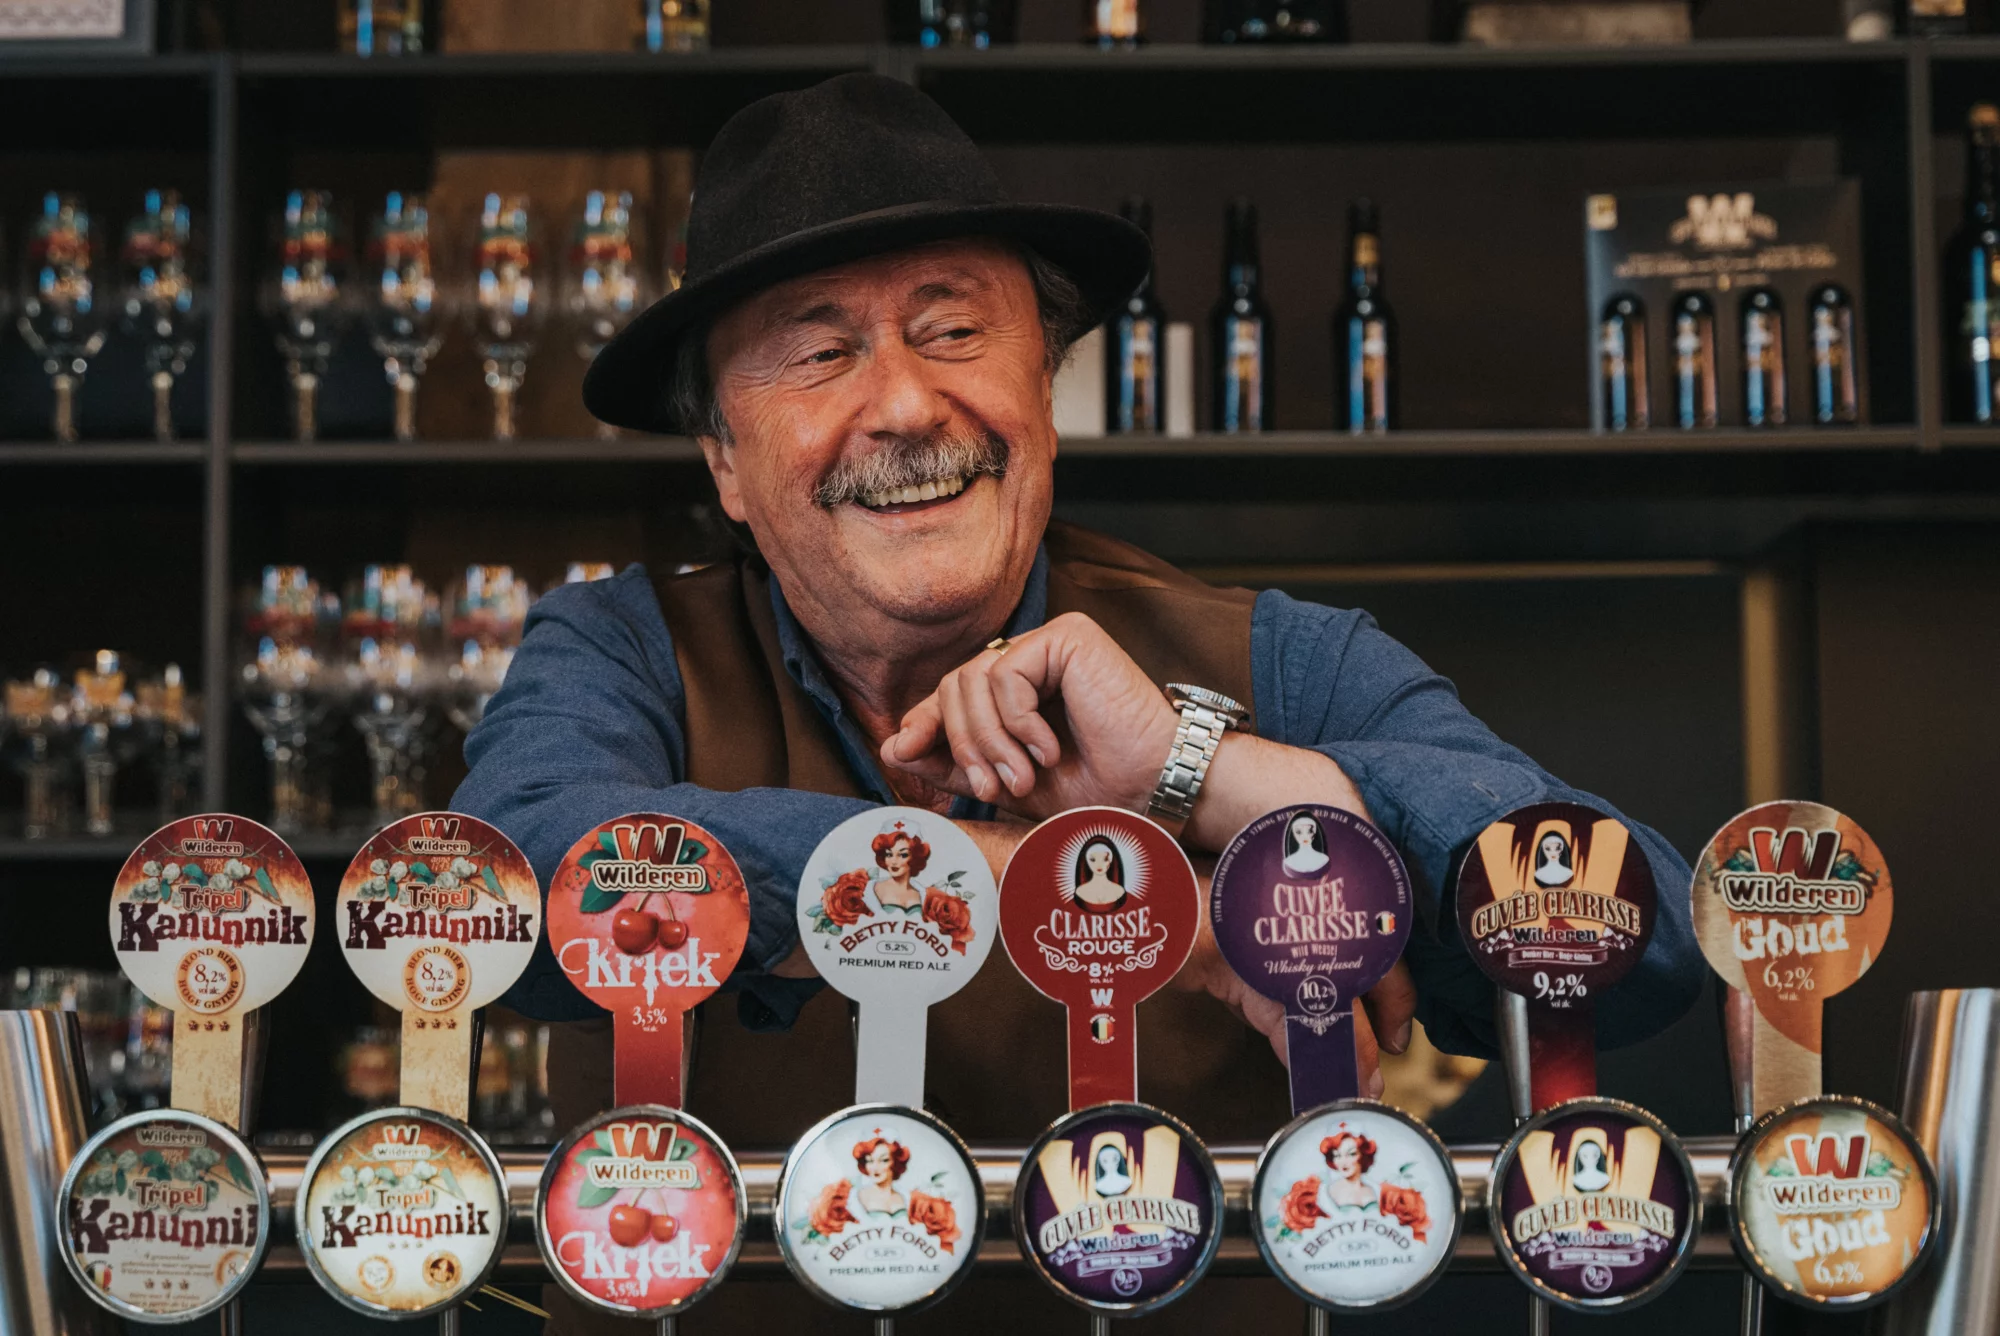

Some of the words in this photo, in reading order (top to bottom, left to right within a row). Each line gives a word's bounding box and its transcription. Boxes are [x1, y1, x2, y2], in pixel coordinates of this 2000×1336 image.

[194, 819, 233, 843] W
[421, 818, 460, 841] W
[183, 840, 242, 854] Wilderen
[410, 839, 468, 852] Wilderen
[613, 824, 685, 865] W
[1232, 837, 1247, 855] BIER
[1250, 816, 1276, 836] STRONG
[1330, 812, 1349, 824] BEER
[1373, 837, 1391, 859] ROUGE
[1396, 881, 1406, 904] FORTE
[1750, 827, 1841, 880] W
[597, 866, 701, 886] Wilderen
[180, 887, 243, 912] Tripel
[407, 884, 469, 910] Tripel
[1273, 874, 1346, 917] CUVÉE
[1728, 878, 1858, 907] Wilderen
[345, 900, 533, 949] Kanunnik
[1050, 906, 1151, 940] CLARISSE
[1474, 891, 1538, 936] CUVÉE
[1542, 889, 1641, 935] CLARISSE
[118, 902, 307, 951] Kanunnik
[840, 920, 898, 953] BETTY
[902, 920, 949, 958] FORD
[1254, 911, 1369, 946] CLARISSE
[1513, 926, 1599, 944] Wilderen
[1733, 914, 1850, 961] Goud
[181, 948, 214, 971] BLOND
[217, 950, 238, 972] BIER
[408, 946, 440, 969] BLOND
[444, 948, 464, 970] BIER
[1068, 940, 1135, 956] ROUGE
[195, 964, 227, 987] 8,2%
[421, 962, 454, 984] 8,2%
[559, 938, 721, 1006] Kriek
[839, 957, 896, 969] PREMIUM
[899, 960, 924, 970] RED
[927, 962, 951, 971] ALE
[1264, 959, 1316, 977] Whisky
[1317, 956, 1364, 976] infused
[1763, 960, 1815, 992] 6,2%
[178, 979, 202, 1006] HOGE
[204, 981, 239, 1009] GISTING
[406, 977, 428, 1004] HOGE
[431, 978, 465, 1006] GISTING
[1090, 988, 1114, 1006] W
[1533, 971, 1587, 1001] 9,2%
[632, 1005, 668, 1027] 3,5%
[140, 1130, 203, 1144] Wilderen
[383, 1125, 421, 1146] W
[608, 1123, 676, 1162] W
[1785, 1130, 1871, 1180] W
[594, 1164, 691, 1182] Wilderen
[135, 1182, 204, 1209] Tripel
[376, 1189, 432, 1209] Tripel
[1773, 1184, 1892, 1205] Wilderen
[321, 1202, 489, 1248] Kanunnik
[1105, 1199, 1200, 1235] CLARISSE
[1581, 1196, 1675, 1238] CLARISSE
[829, 1226, 884, 1262] BETTY
[890, 1225, 938, 1259] FORD
[1080, 1232, 1161, 1252] Wilderen
[1303, 1221, 1357, 1258] BETTY
[1362, 1218, 1410, 1250] FORD
[1553, 1230, 1634, 1247] Wilderen
[1781, 1210, 1890, 1261] Goud
[557, 1231, 711, 1296] Kriek
[829, 1265, 886, 1276] PREMIUM
[889, 1265, 914, 1274] RED
[917, 1264, 941, 1273] ALE
[1303, 1259, 1361, 1273] PREMIUM
[1364, 1257, 1389, 1267] RED
[1391, 1255, 1416, 1265] ALE
